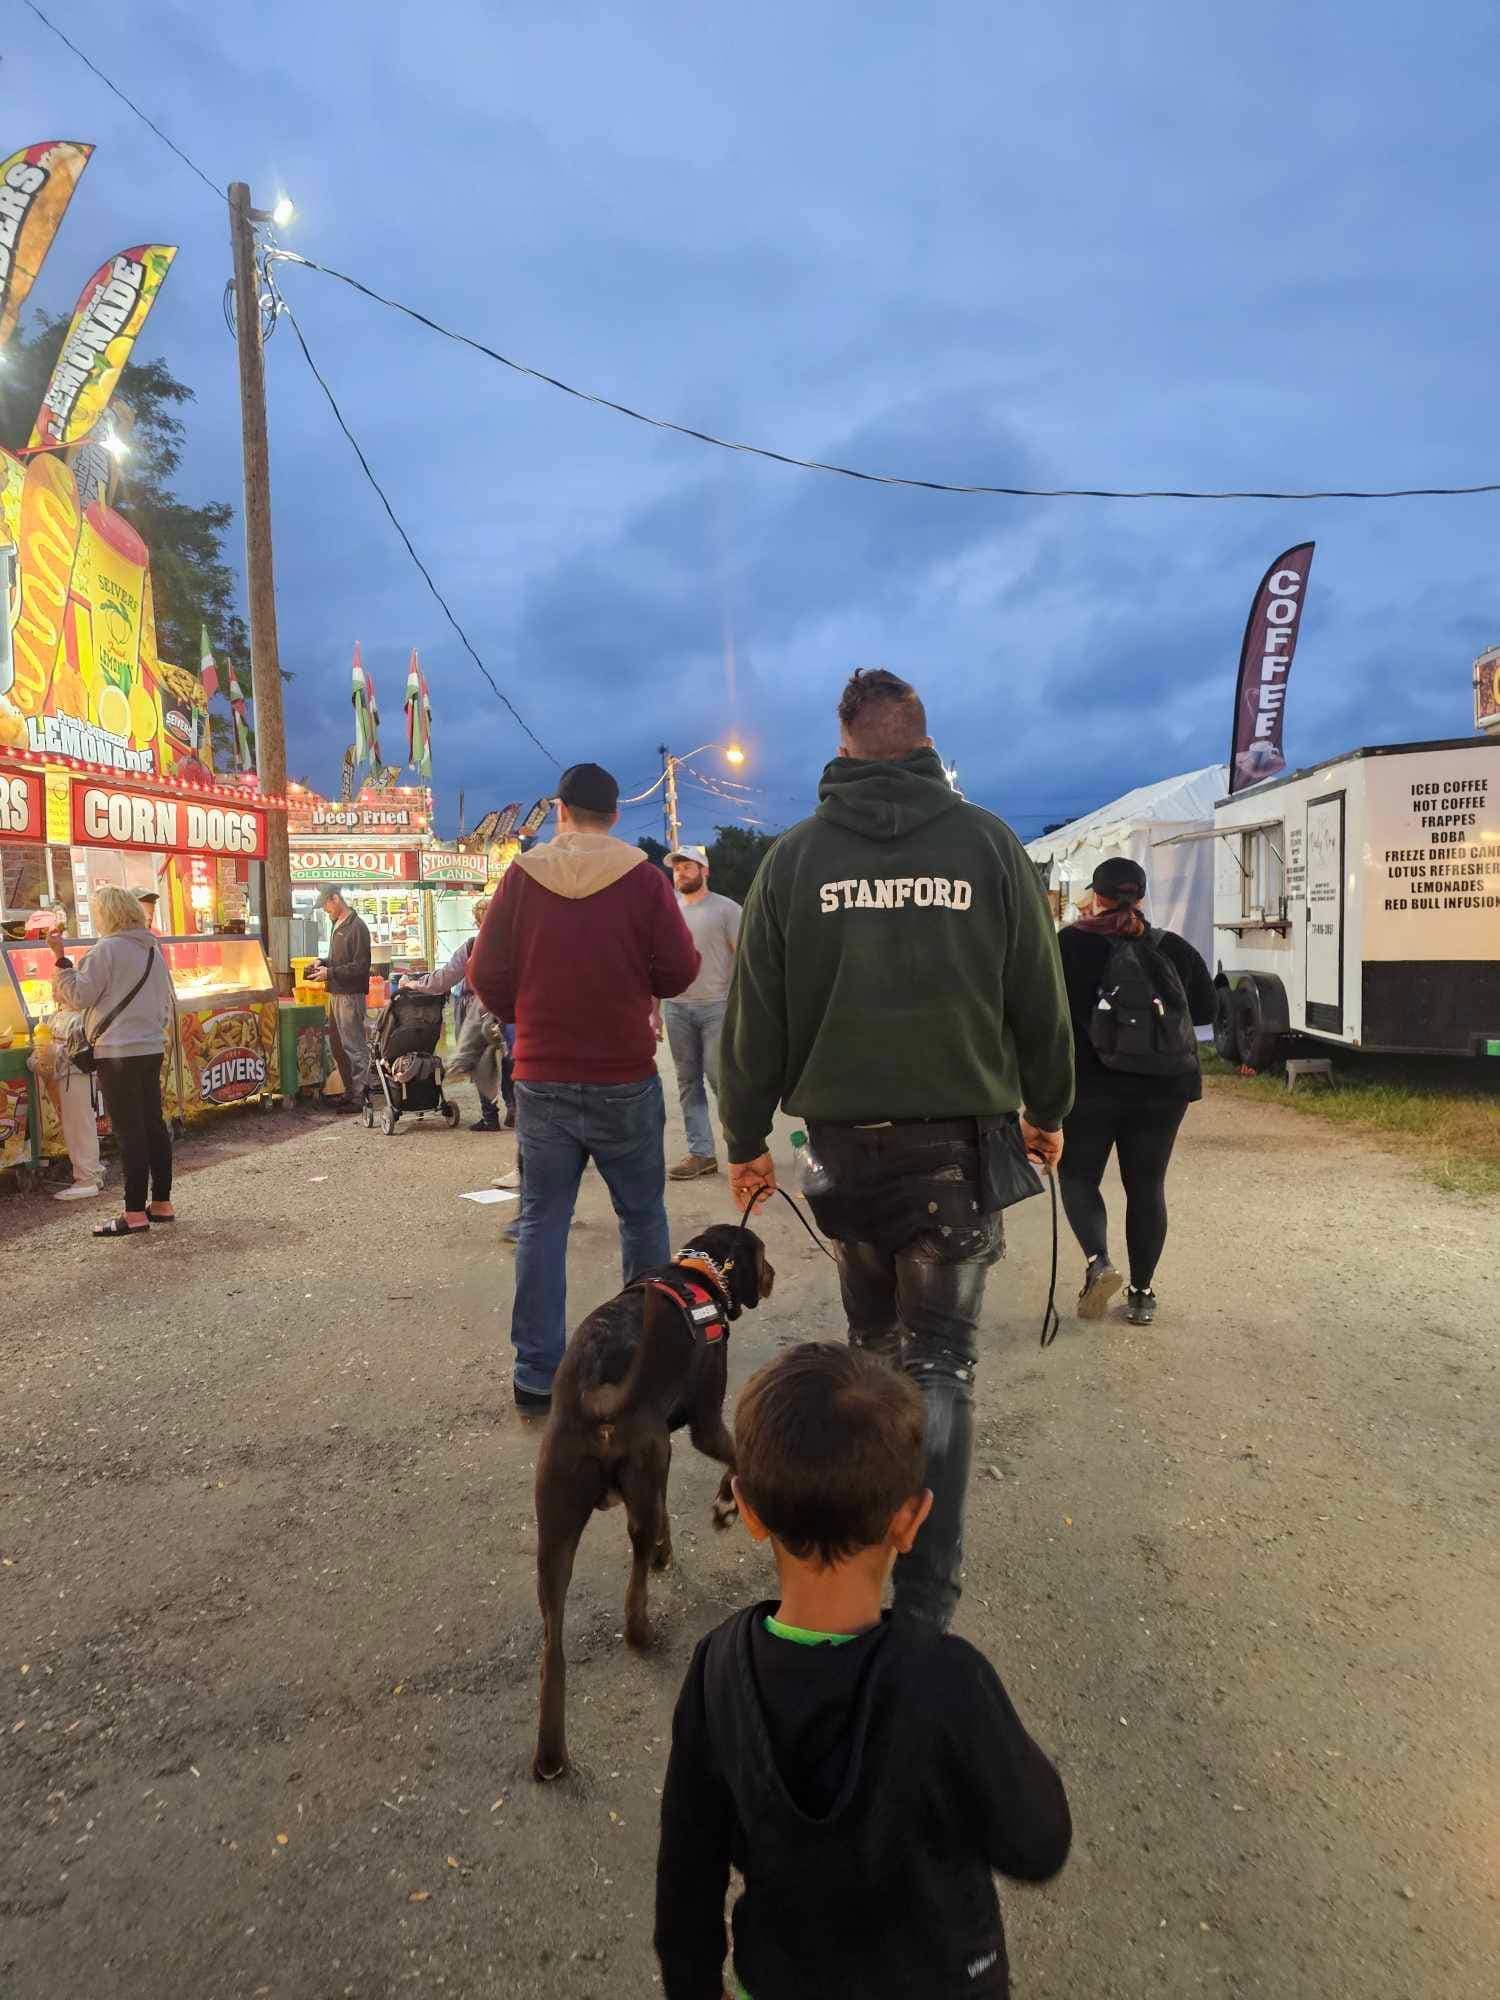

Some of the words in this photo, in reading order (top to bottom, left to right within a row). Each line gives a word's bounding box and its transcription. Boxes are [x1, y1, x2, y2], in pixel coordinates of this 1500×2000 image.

[47, 256, 144, 442] LEMONADE
[98, 574, 139, 613] SEIVERS
[1254, 569, 1300, 738] COFFEE
[26, 715, 154, 774] LEMONADE
[1411, 783, 1440, 796] ICED
[1443, 779, 1488, 794] COFFEE
[1413, 800, 1438, 812] HOT
[1441, 796, 1485, 810] COFFEE
[84, 789, 177, 846] CORN
[186, 805, 257, 853] DOGS
[312, 810, 359, 829] Deep
[363, 810, 408, 826] Fried
[1421, 813, 1476, 828] FRAPPES
[1431, 831, 1466, 843] BOBA
[1385, 850, 1425, 862] FREEZE
[1429, 847, 1466, 860] DRIED
[423, 854, 487, 875] STROMBOLI
[1388, 865, 1426, 878] LOTUS
[1430, 862, 1500, 877] REFRESHER
[323, 870, 367, 879] DRINKS
[440, 869, 473, 880] LAND
[819, 877, 972, 913] STANFORD
[1411, 880, 1484, 893] LEMONADES
[1384, 899, 1407, 911] RED
[1411, 898, 1440, 910] BULL
[201, 1058, 266, 1098] SEIVERS
